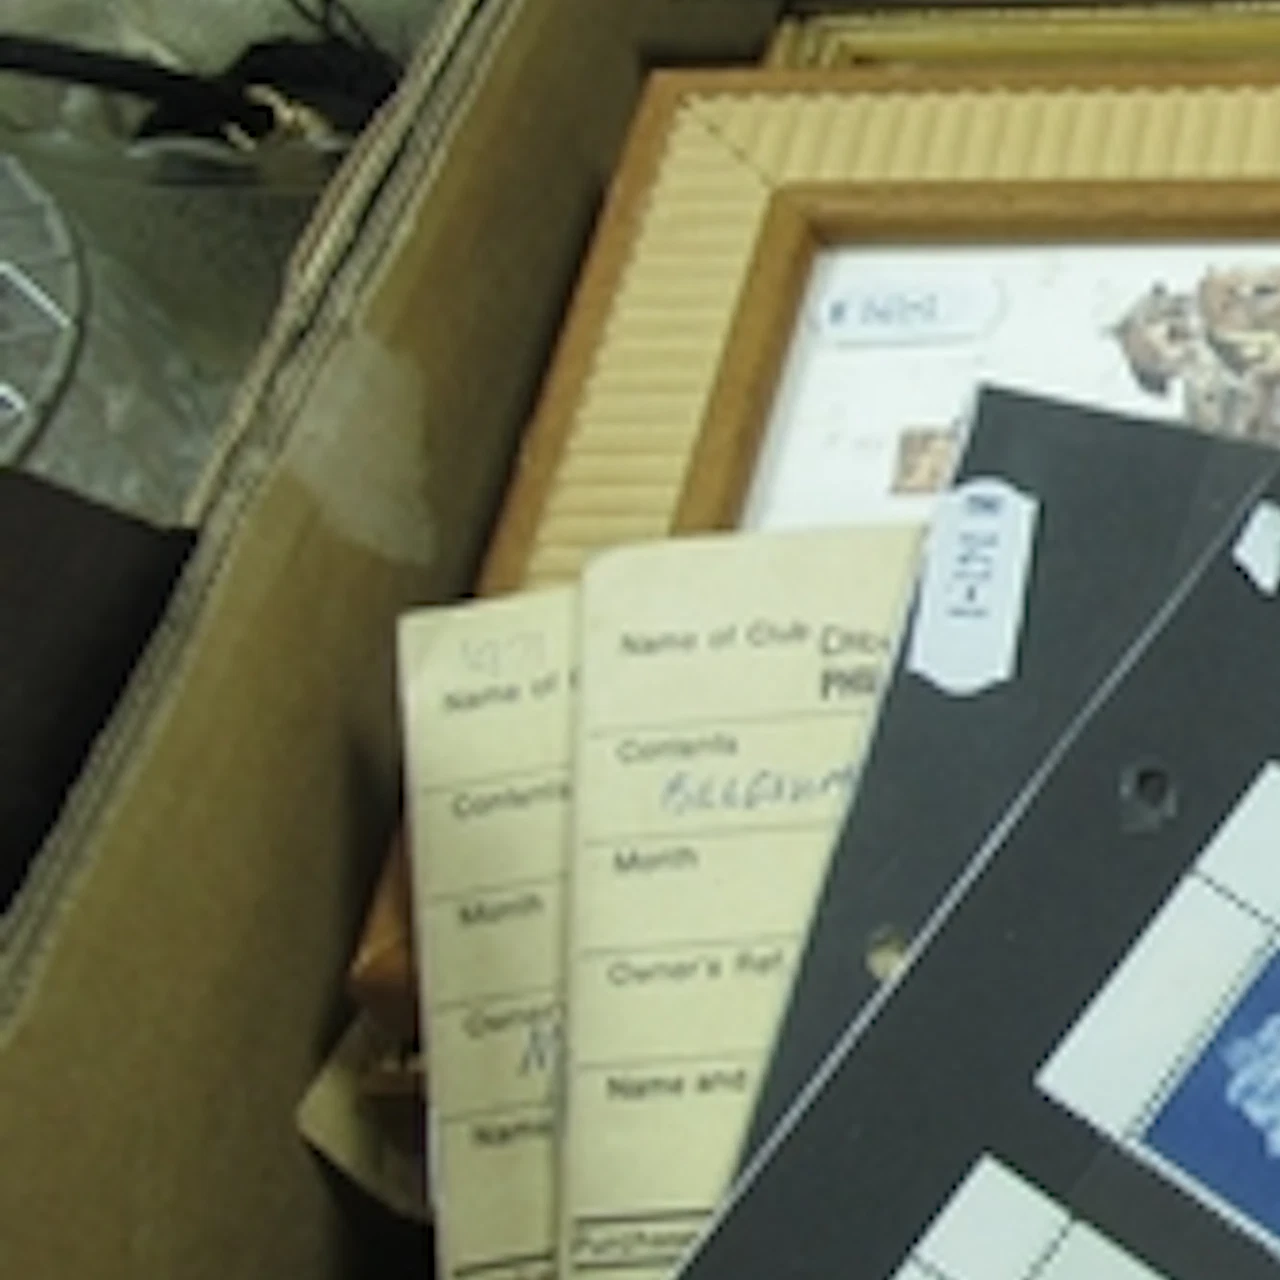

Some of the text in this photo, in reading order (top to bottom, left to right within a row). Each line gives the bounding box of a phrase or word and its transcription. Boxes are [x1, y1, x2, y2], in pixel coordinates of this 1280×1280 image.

[621, 630, 698, 656] Name
[706, 622, 738, 652] of
[745, 616, 811, 649] Club
[614, 732, 738, 766] Contents
[612, 846, 700, 876] Month
[458, 892, 545, 927] Month
[606, 956, 722, 988] Owner's
[606, 1068, 748, 1102] Name and
